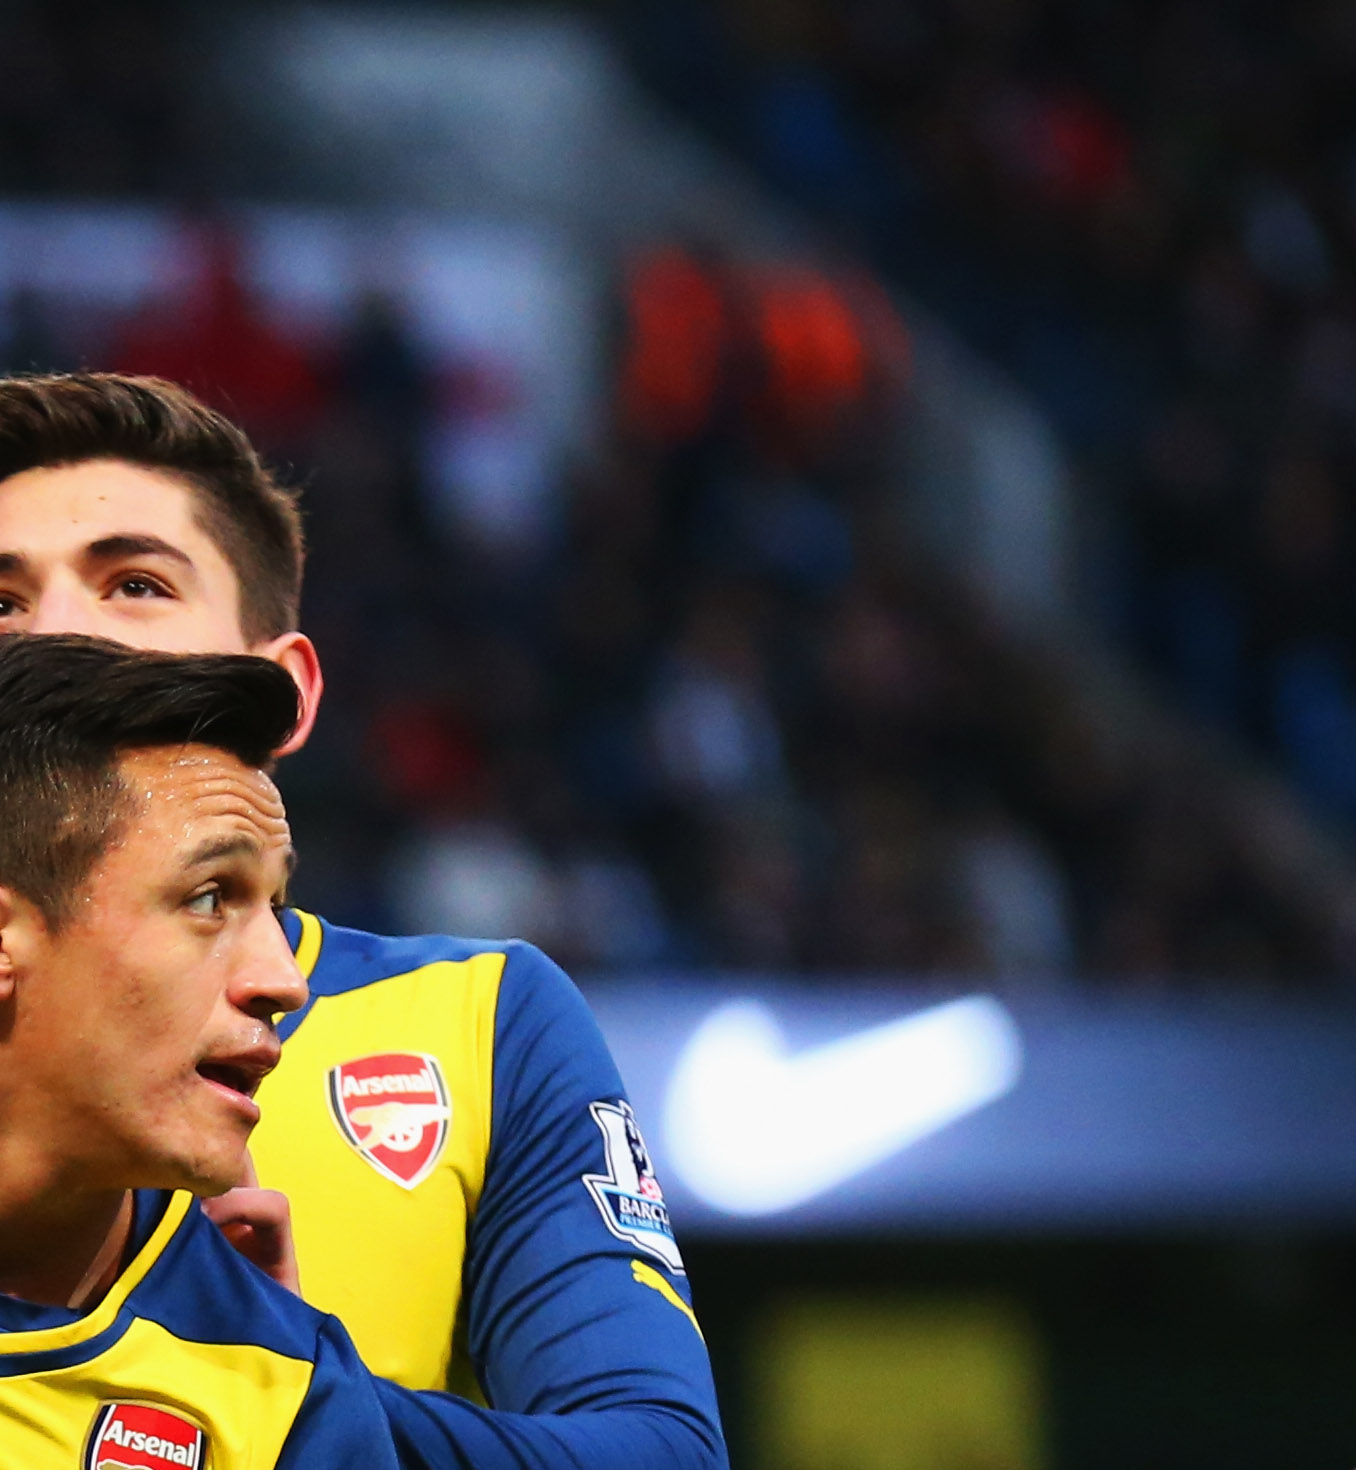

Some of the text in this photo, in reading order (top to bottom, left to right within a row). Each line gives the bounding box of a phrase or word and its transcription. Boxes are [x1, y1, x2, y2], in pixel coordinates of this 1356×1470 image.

[342, 1068, 435, 1098] Arsenal
[619, 1195, 671, 1226] BARCL
[103, 1420, 196, 1468] Arsenal
